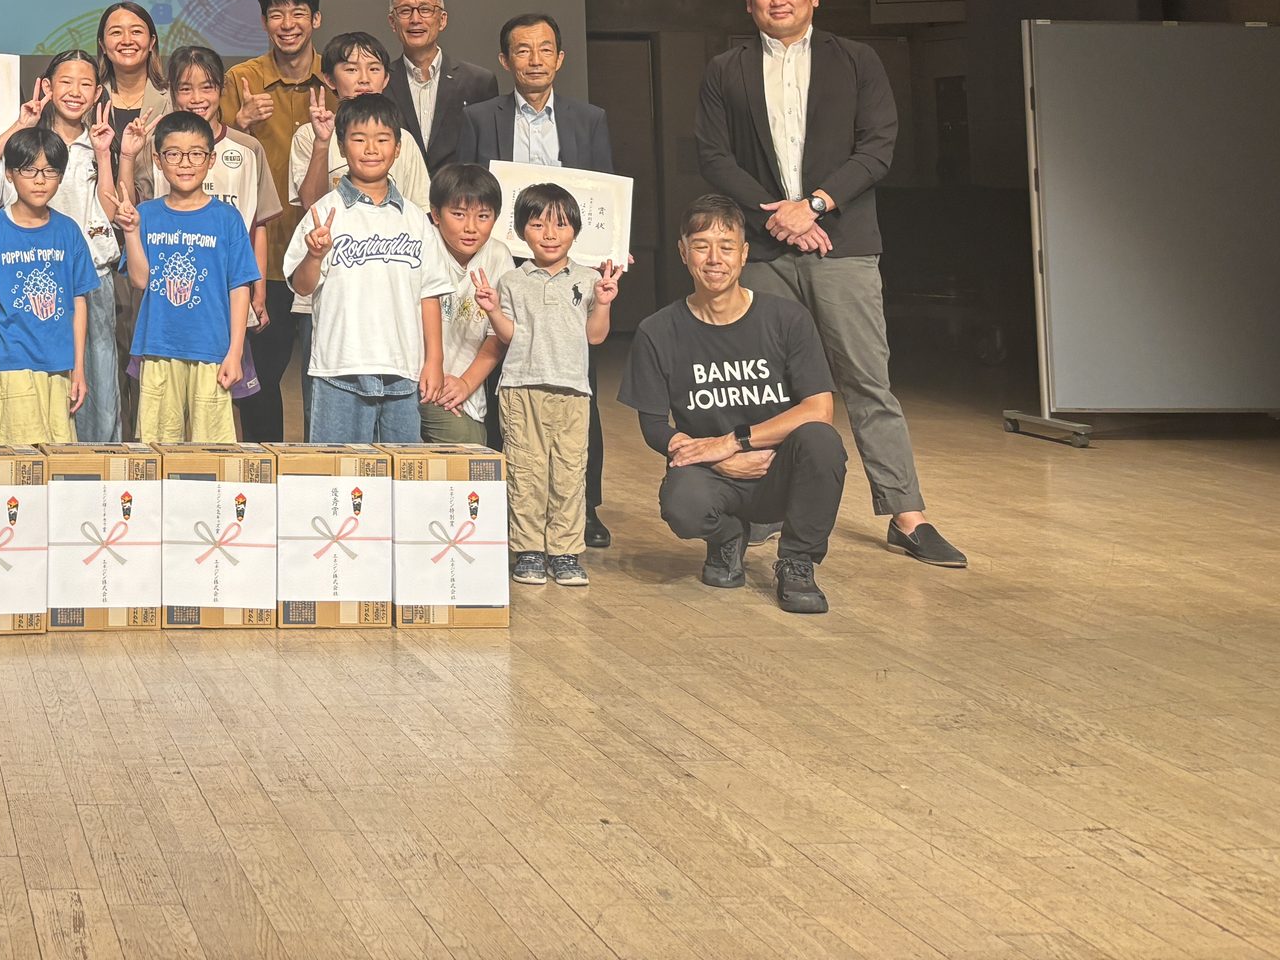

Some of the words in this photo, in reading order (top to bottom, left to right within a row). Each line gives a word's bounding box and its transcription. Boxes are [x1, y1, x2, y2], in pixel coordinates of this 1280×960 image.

[147, 231, 179, 246] POPPING
[182, 232, 217, 248] POPCORN
[1, 250, 35, 266] POPPING
[692, 358, 770, 384] BANKS
[687, 382, 790, 410] JOURNAL
[331, 487, 339, 516] 優秀賞
